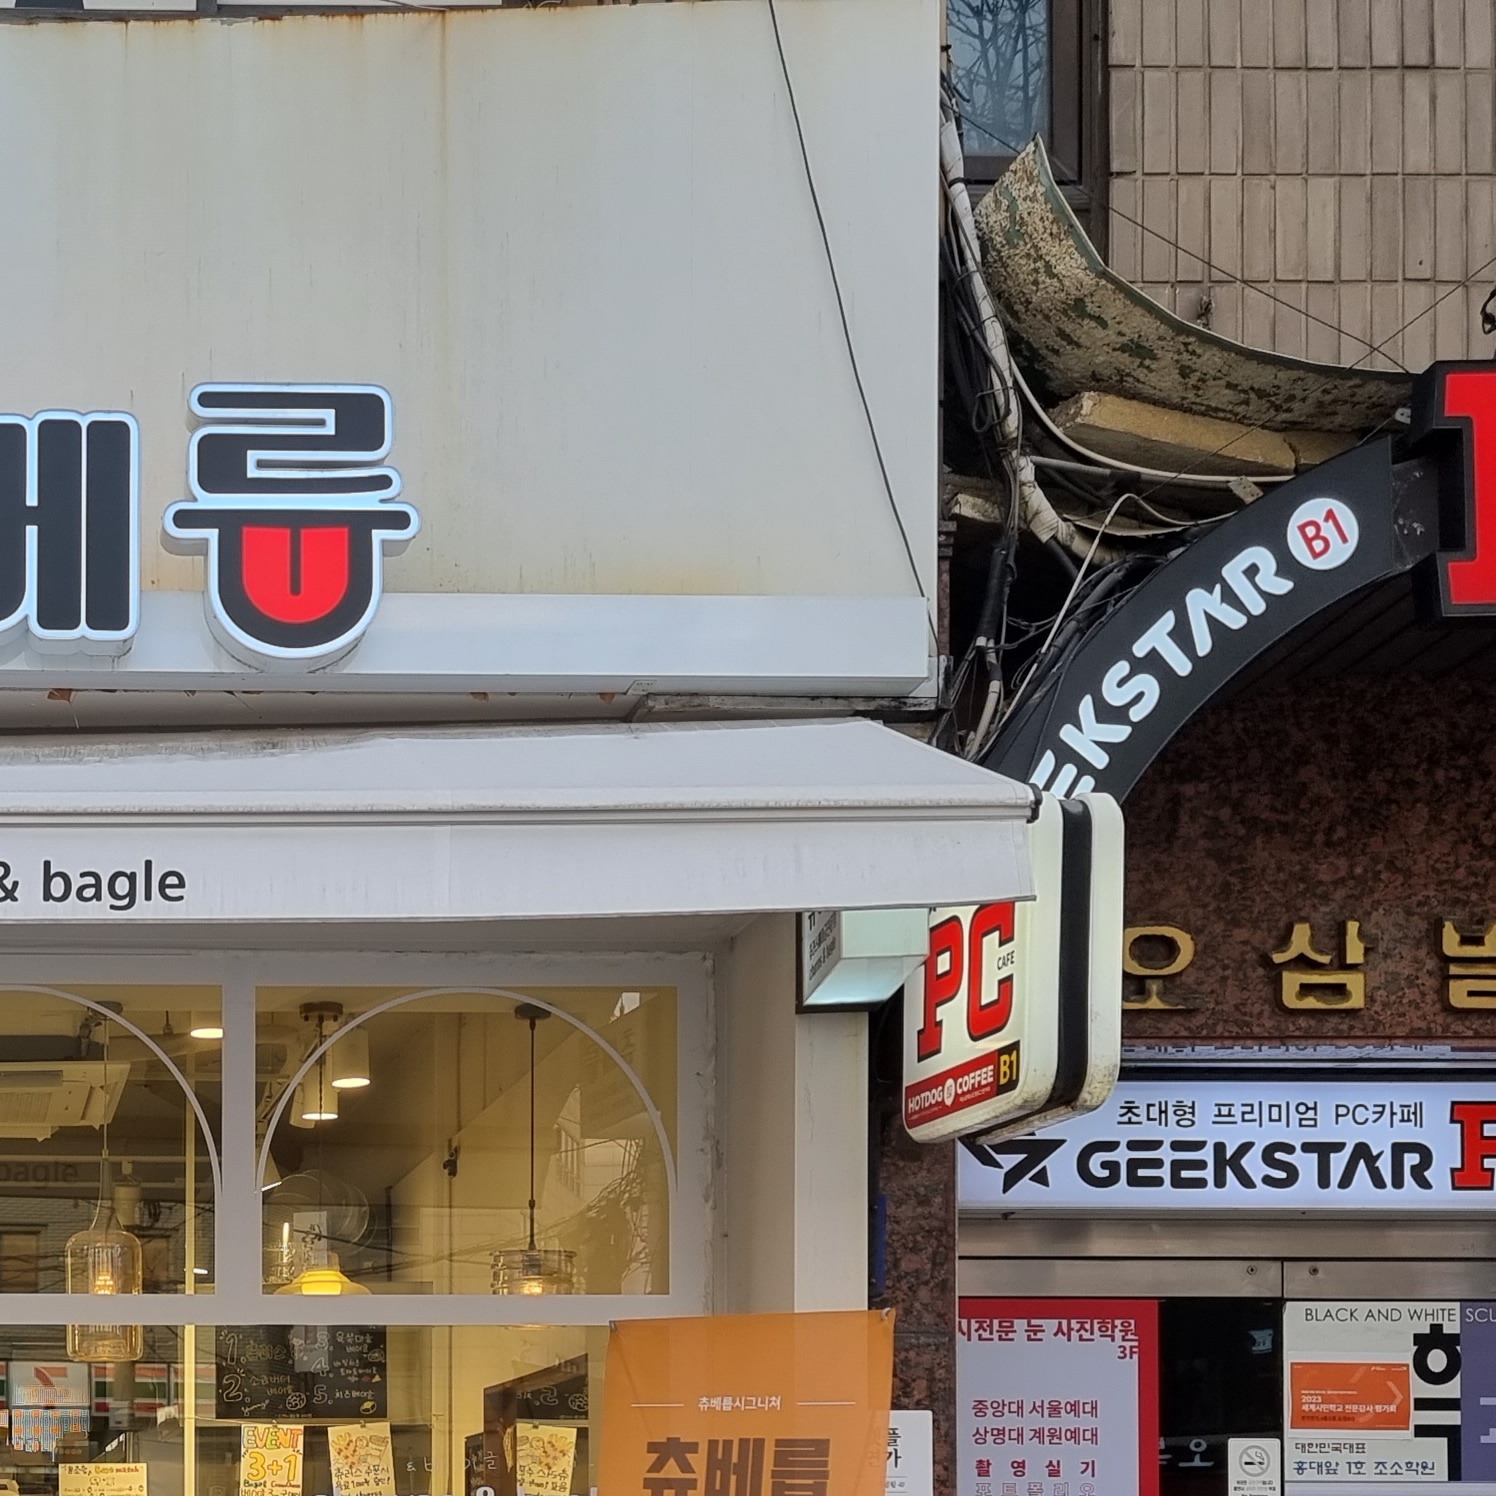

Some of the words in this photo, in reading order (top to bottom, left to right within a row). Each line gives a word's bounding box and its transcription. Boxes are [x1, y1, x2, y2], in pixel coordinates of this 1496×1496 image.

[1296, 507, 1350, 562] B1
[42, 860, 187, 912] bagle
[997, 950, 1016, 971] CAFE
[916, 901, 1016, 1064] PC
[999, 1050, 1017, 1086] B1
[908, 1086, 943, 1114] HOTDOG
[956, 1065, 994, 1095] COFFEE
[1117, 1101, 1197, 1127] 초대형
[1211, 1101, 1319, 1128] 프리미엄
[1334, 1101, 1425, 1128] PC카페
[1076, 1140, 1434, 1189] GEEKSTAR
[1305, 1308, 1359, 1322] BLACK
[1364, 1308, 1402, 1322] AND
[1407, 1308, 1456, 1322] WHITE
[1024, 1319, 1046, 1342] 눈
[1053, 1319, 1139, 1342] 사진학원
[1116, 1345, 1139, 1360] 3F
[698, 1396, 781, 1411] 츄베릅시그니처
[971, 1399, 1025, 1419] 중앙대
[1028, 1399, 1099, 1419] 서울예대
[1301, 1395, 1322, 1403] 2023
[243, 1426, 303, 1450] EVENT
[971, 1427, 1025, 1446] 상명대
[1028, 1427, 1099, 1446] 계원예대
[1295, 1442, 1366, 1454] 대한민국대표
[247, 1451, 298, 1482] 3+1
[1293, 1460, 1340, 1476] 홍대앞
[1346, 1460, 1366, 1476] 1호
[1373, 1460, 1435, 1476] 조소학원
